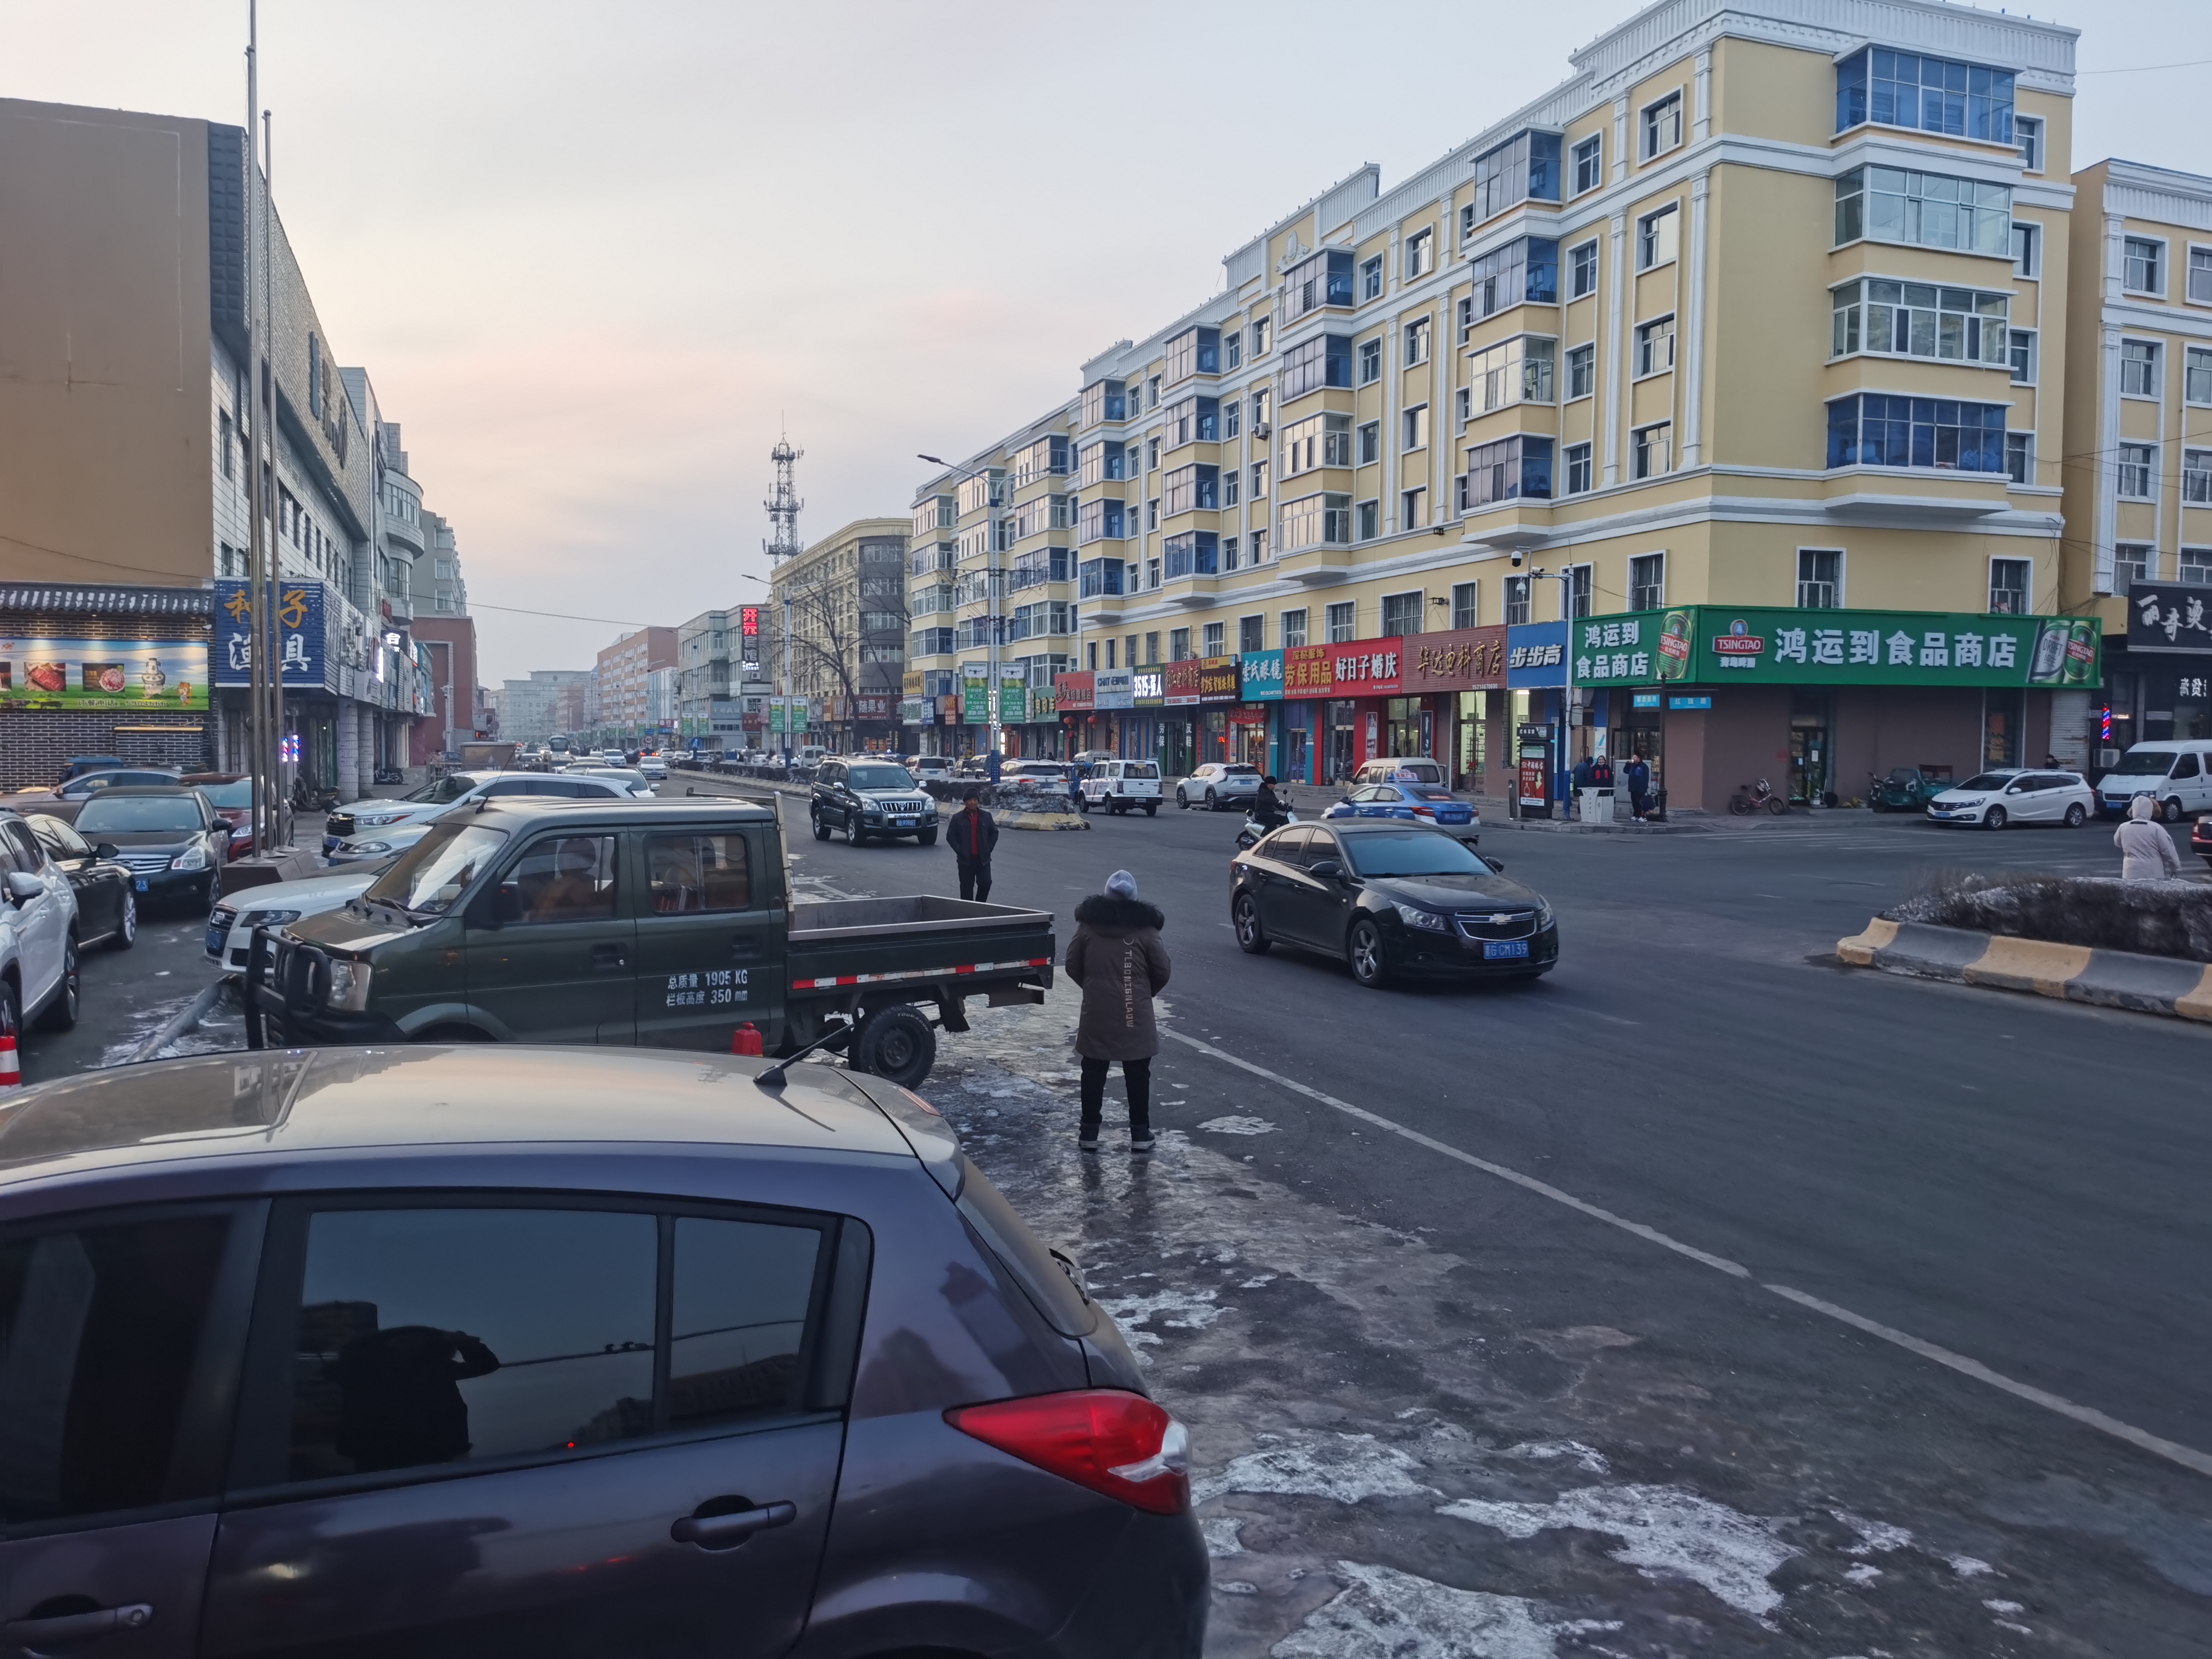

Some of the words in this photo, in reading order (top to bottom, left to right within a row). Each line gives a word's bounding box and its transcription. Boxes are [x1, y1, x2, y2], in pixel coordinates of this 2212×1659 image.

[743, 608, 757, 661] 开元宾馆
[1585, 620, 1639, 648] 鸿运到
[1660, 635, 1687, 652] TSINGTAO
[1717, 639, 1761, 651] TSINGTAO
[1509, 644, 1563, 668] 步步高
[1774, 627, 2017, 668] 鸿运到食品商店
[2068, 642, 2093, 657] TSINGTAO
[1242, 659, 1282, 683] 索氏眼镜
[1285, 661, 1332, 686] 劳保用品
[1335, 651, 1398, 682] 好日子婚庆
[1577, 651, 1649, 679] 食品商店
[668, 973, 699, 990] 总质量
[705, 970, 731, 987] 1905
[735, 970, 748, 985] KG
[666, 990, 705, 1007] 栏板高度
[711, 988, 732, 1004] 350
[735, 990, 748, 1002] mm
